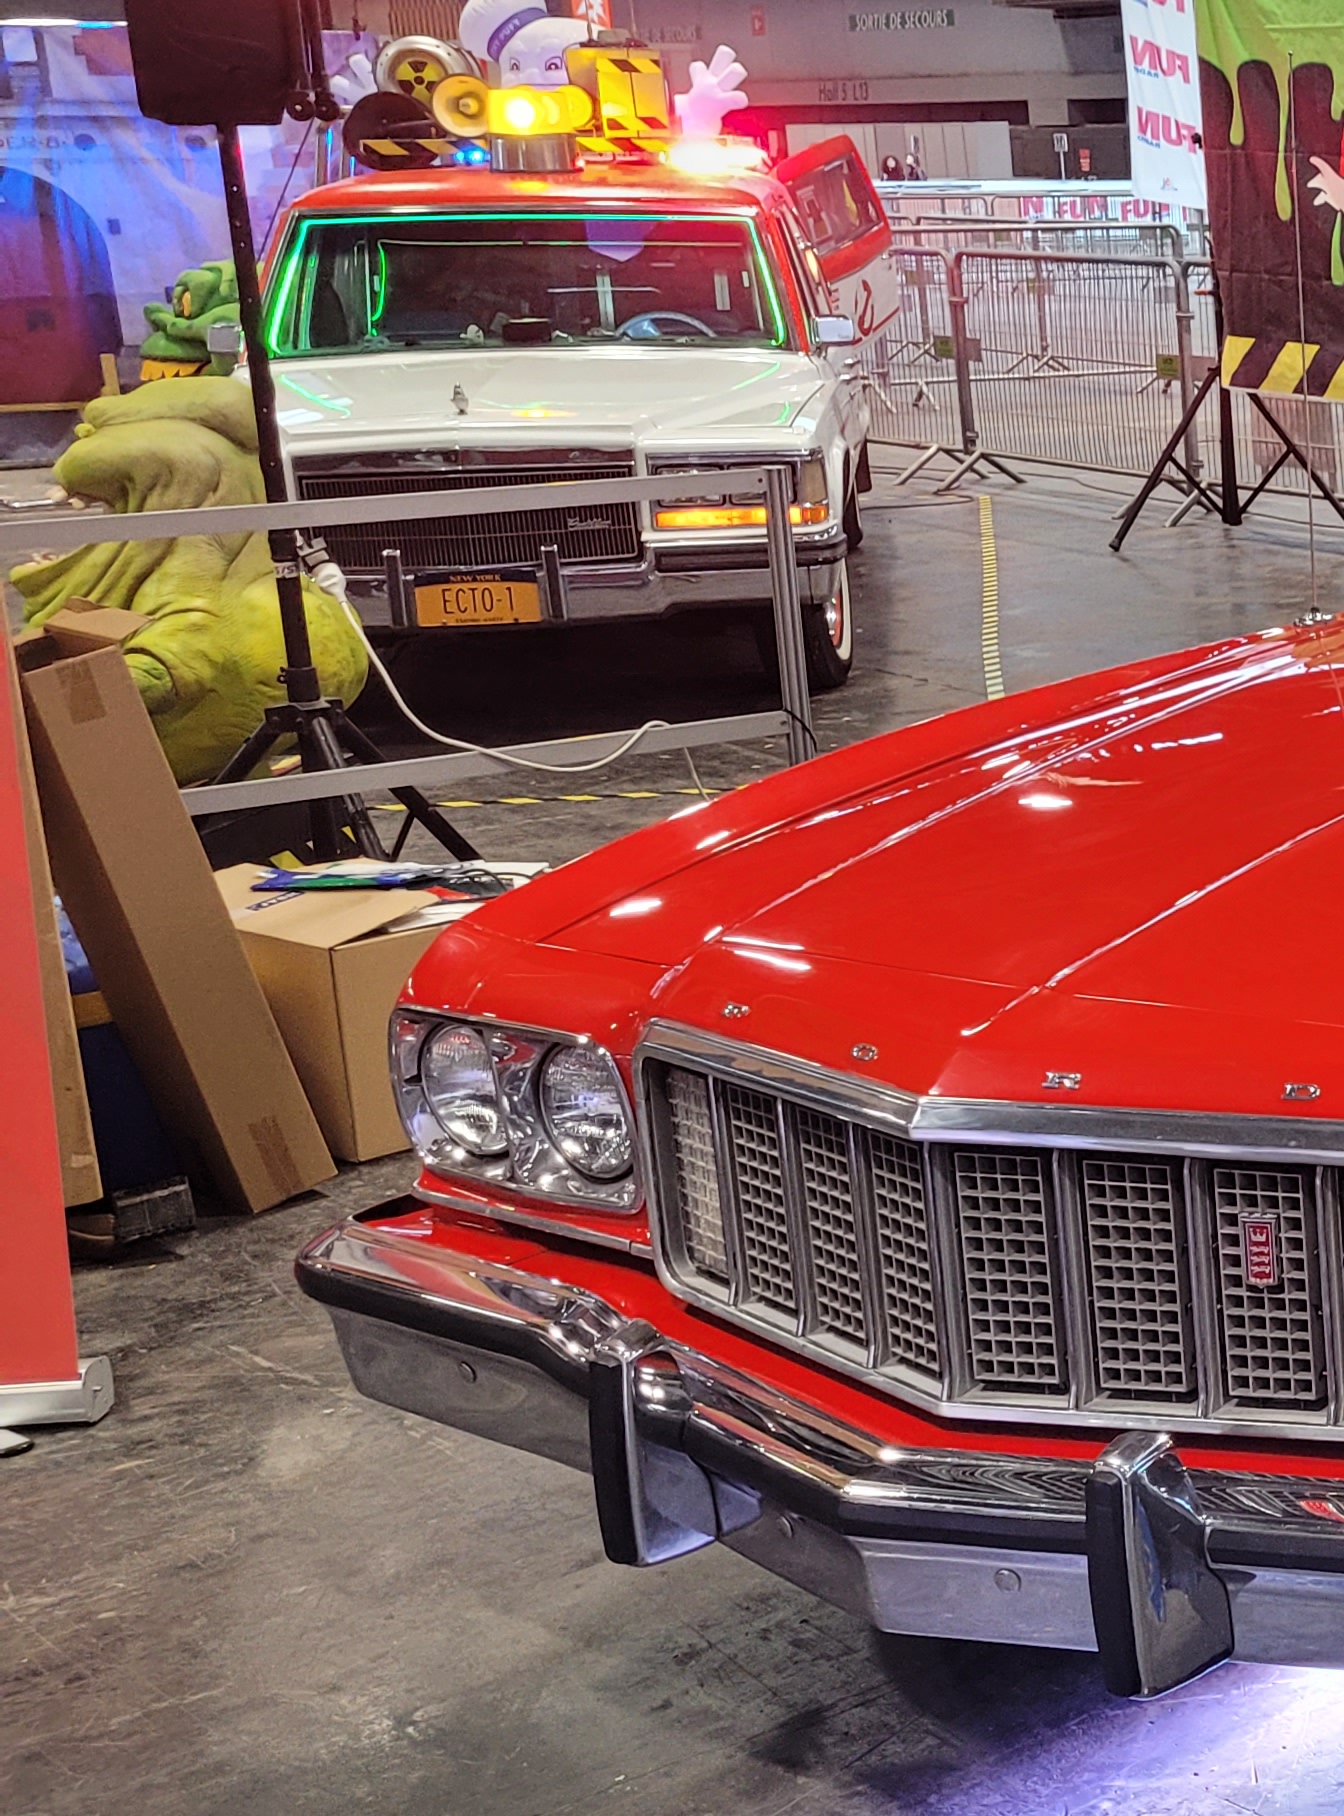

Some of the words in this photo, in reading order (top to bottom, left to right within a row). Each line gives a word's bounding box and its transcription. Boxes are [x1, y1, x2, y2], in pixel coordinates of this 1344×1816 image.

[855, 13, 888, 31] SORTIE
[890, 12, 902, 30] DE
[905, 10, 948, 30] SECOURS
[819, 83, 839, 101] Hall
[449, 574, 474, 584] NEW
[475, 573, 502, 583] YORK
[441, 586, 514, 615] ECTO-1
